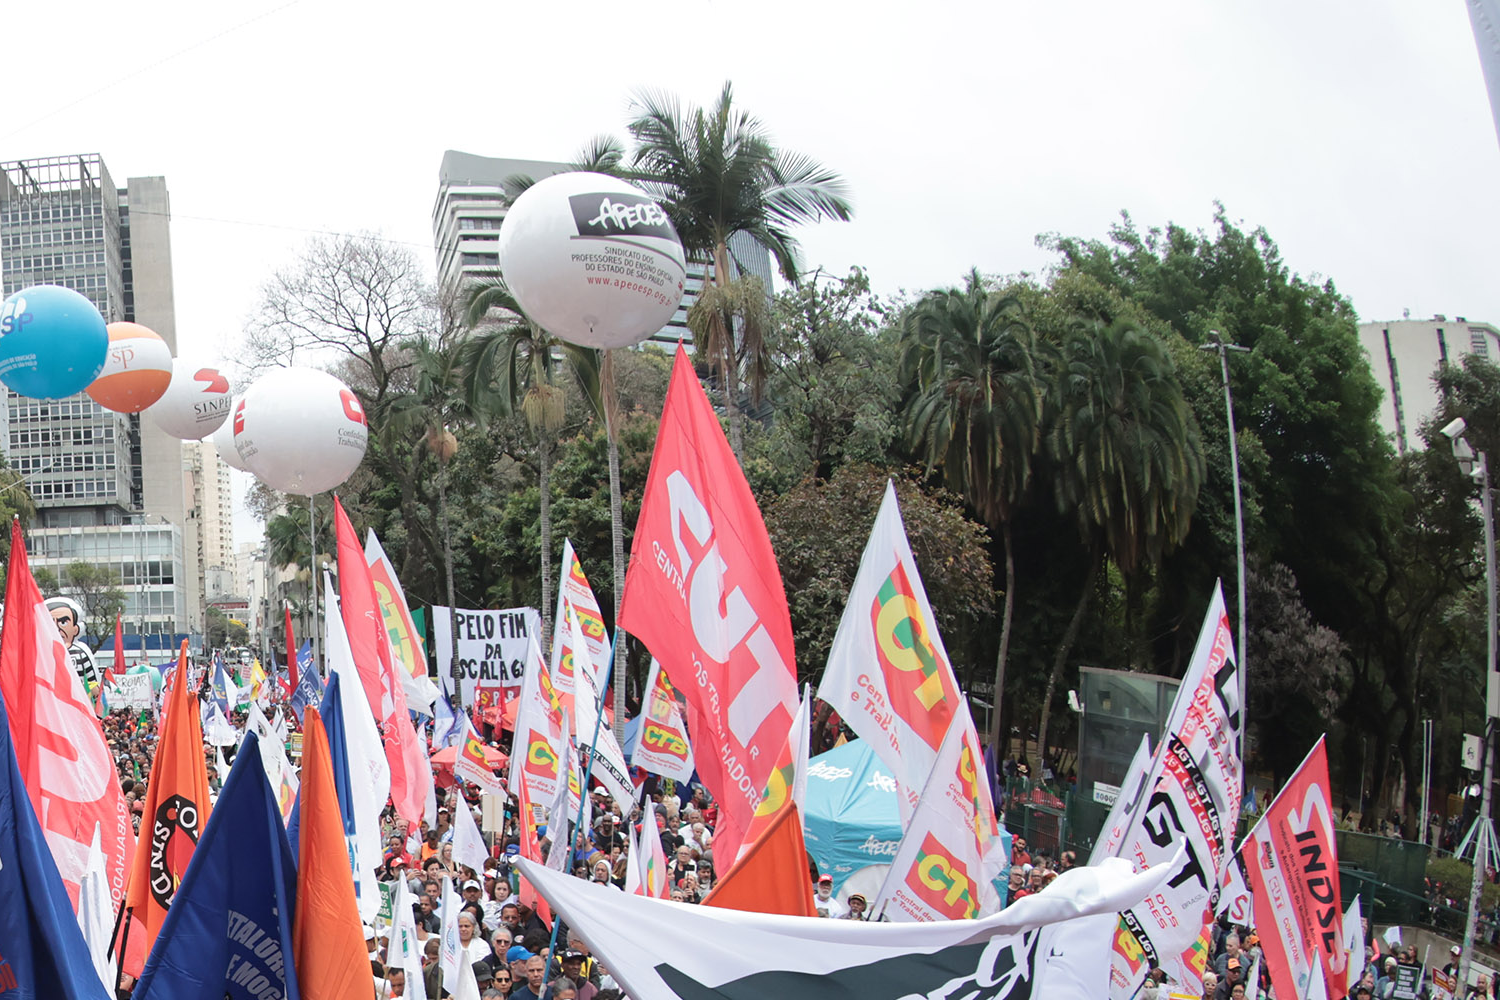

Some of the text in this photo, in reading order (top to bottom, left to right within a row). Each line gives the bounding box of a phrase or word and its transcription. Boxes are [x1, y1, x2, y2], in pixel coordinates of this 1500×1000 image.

[571, 254, 622, 265] PROFESSORES
[624, 259, 634, 267] DO
[635, 262, 656, 273] ENSINO
[604, 246, 654, 264] SINDICATO DOS
[585, 263, 595, 271] DO
[597, 264, 625, 275] ESTADO
[626, 268, 635, 277] DE
[648, 272, 665, 286] PAULO
[666, 469, 800, 749] CUT
[457, 613, 494, 640] PELO
[485, 644, 502, 660] DA
[644, 725, 689, 757] CTB
[1171, 741, 1196, 776] UGT
[1192, 773, 1212, 810] UGT
[1182, 776, 1200, 808] UGT
[1156, 893, 1179, 928] DOS
[1139, 938, 1157, 963] UGT
